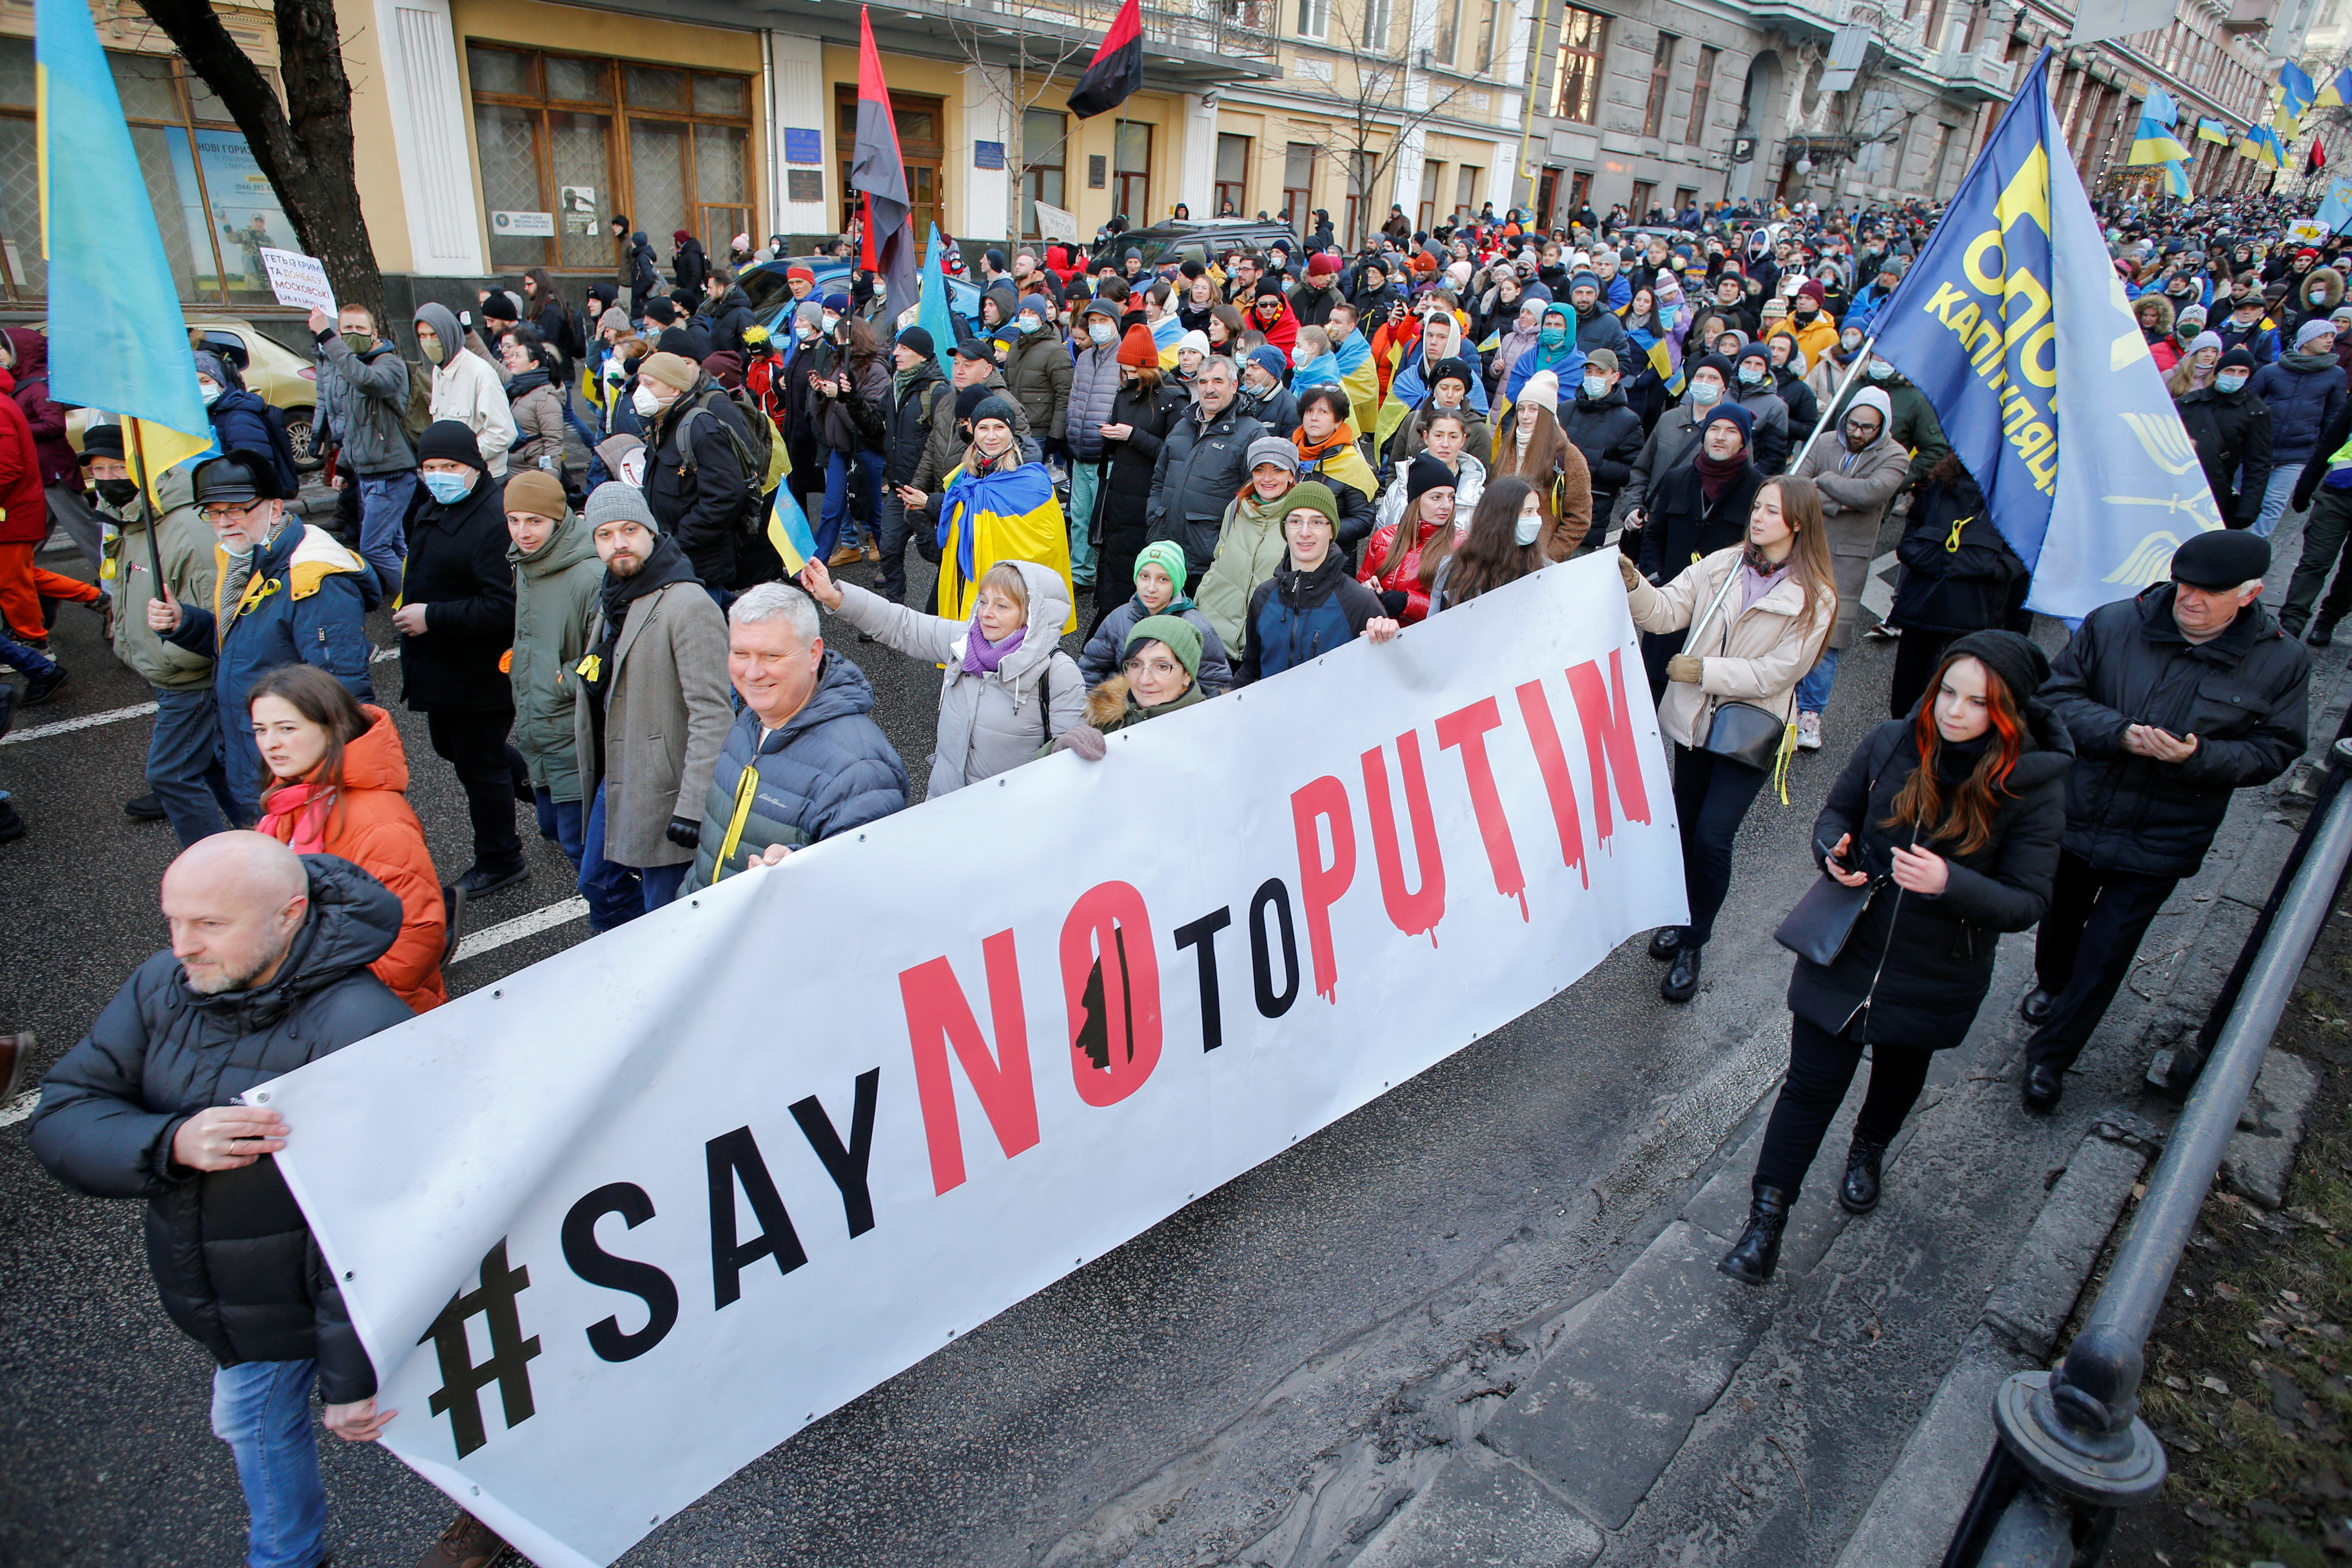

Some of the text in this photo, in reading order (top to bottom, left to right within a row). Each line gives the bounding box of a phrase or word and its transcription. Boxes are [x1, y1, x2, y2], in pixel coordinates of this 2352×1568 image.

[198, 142, 220, 152] НОВІ
[1735, 140, 1749, 155] P
[265, 254, 324, 274] ГЕТЬ ІЗ КРИМУ
[269, 267, 283, 276] ТА
[275, 280, 330, 299] МОСКОВСЬКІ
[1963, 230, 2057, 414] ОПО
[416, 647, 1651, 1461] #SAY NO TO PUTIN
